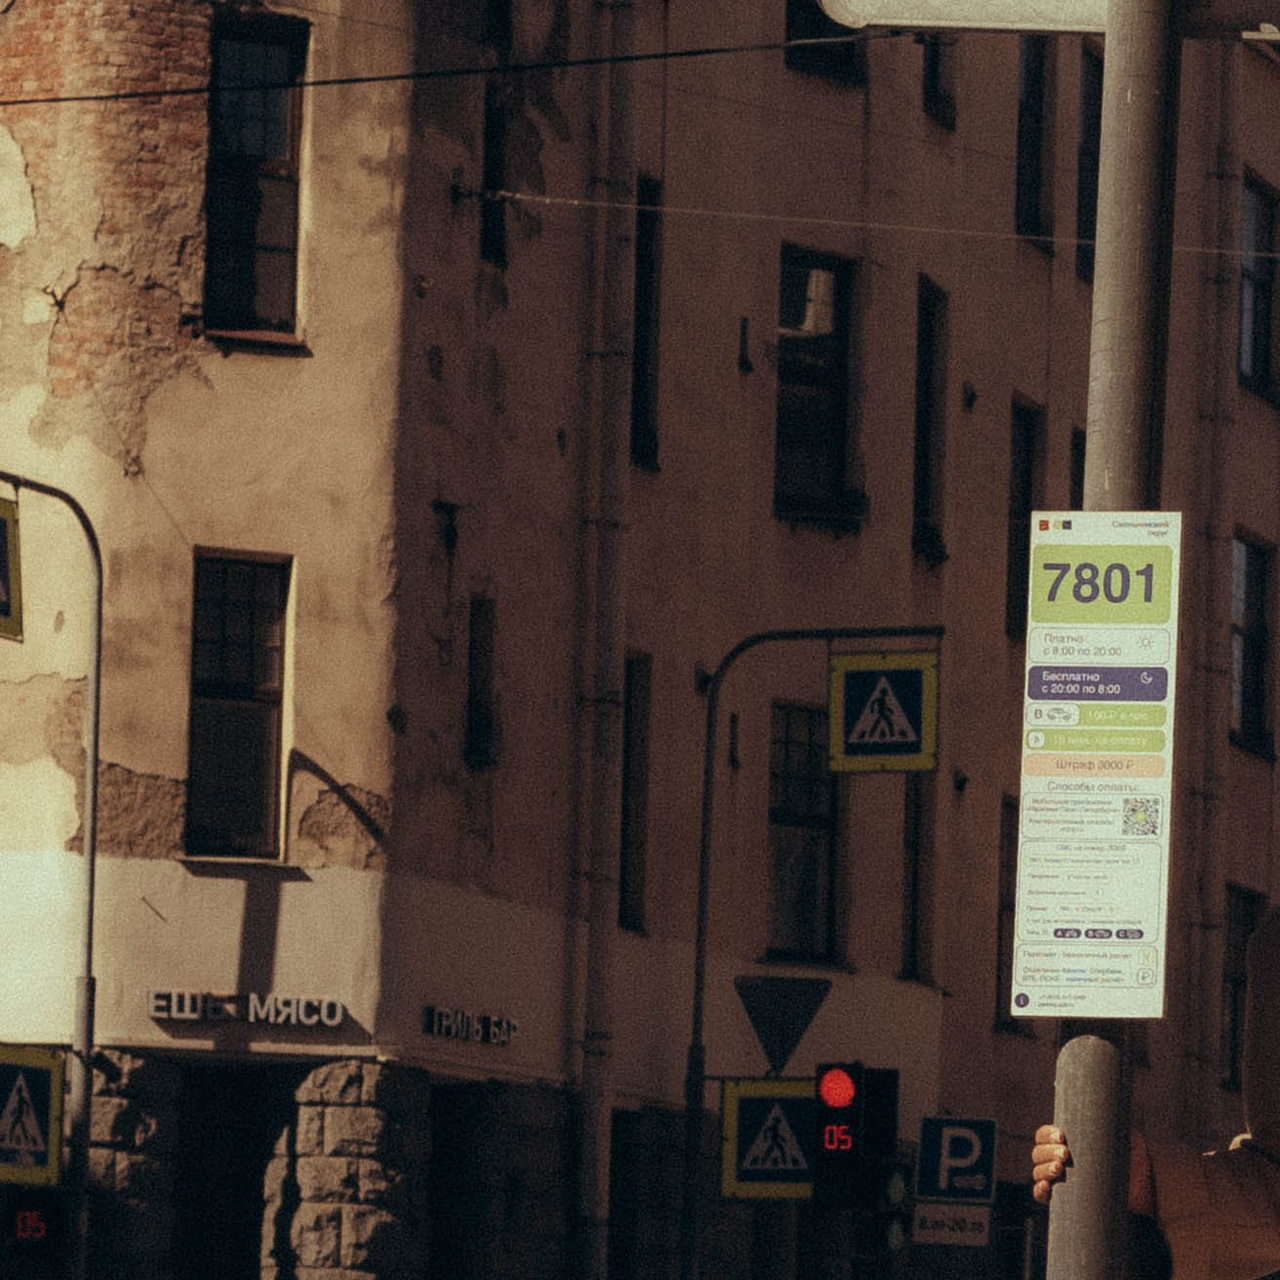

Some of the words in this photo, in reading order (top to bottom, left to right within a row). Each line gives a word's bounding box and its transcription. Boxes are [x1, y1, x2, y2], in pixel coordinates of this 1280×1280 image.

[1042, 562, 1155, 604] 7801
[1044, 632, 1084, 644] Платно
[1042, 671, 1101, 682] Бесплатно
[1041, 685, 1049, 693] с
[1050, 683, 1081, 694] 20:00
[1082, 685, 1096, 694] по
[1098, 684, 1121, 695] 8:00
[1056, 759, 1096, 771] Штраф
[1047, 781, 1095, 792] Способы
[247, 992, 344, 1027] МЯСО
[432, 1005, 483, 1041] ГРИЛЬ
[823, 1125, 852, 1150] 05
